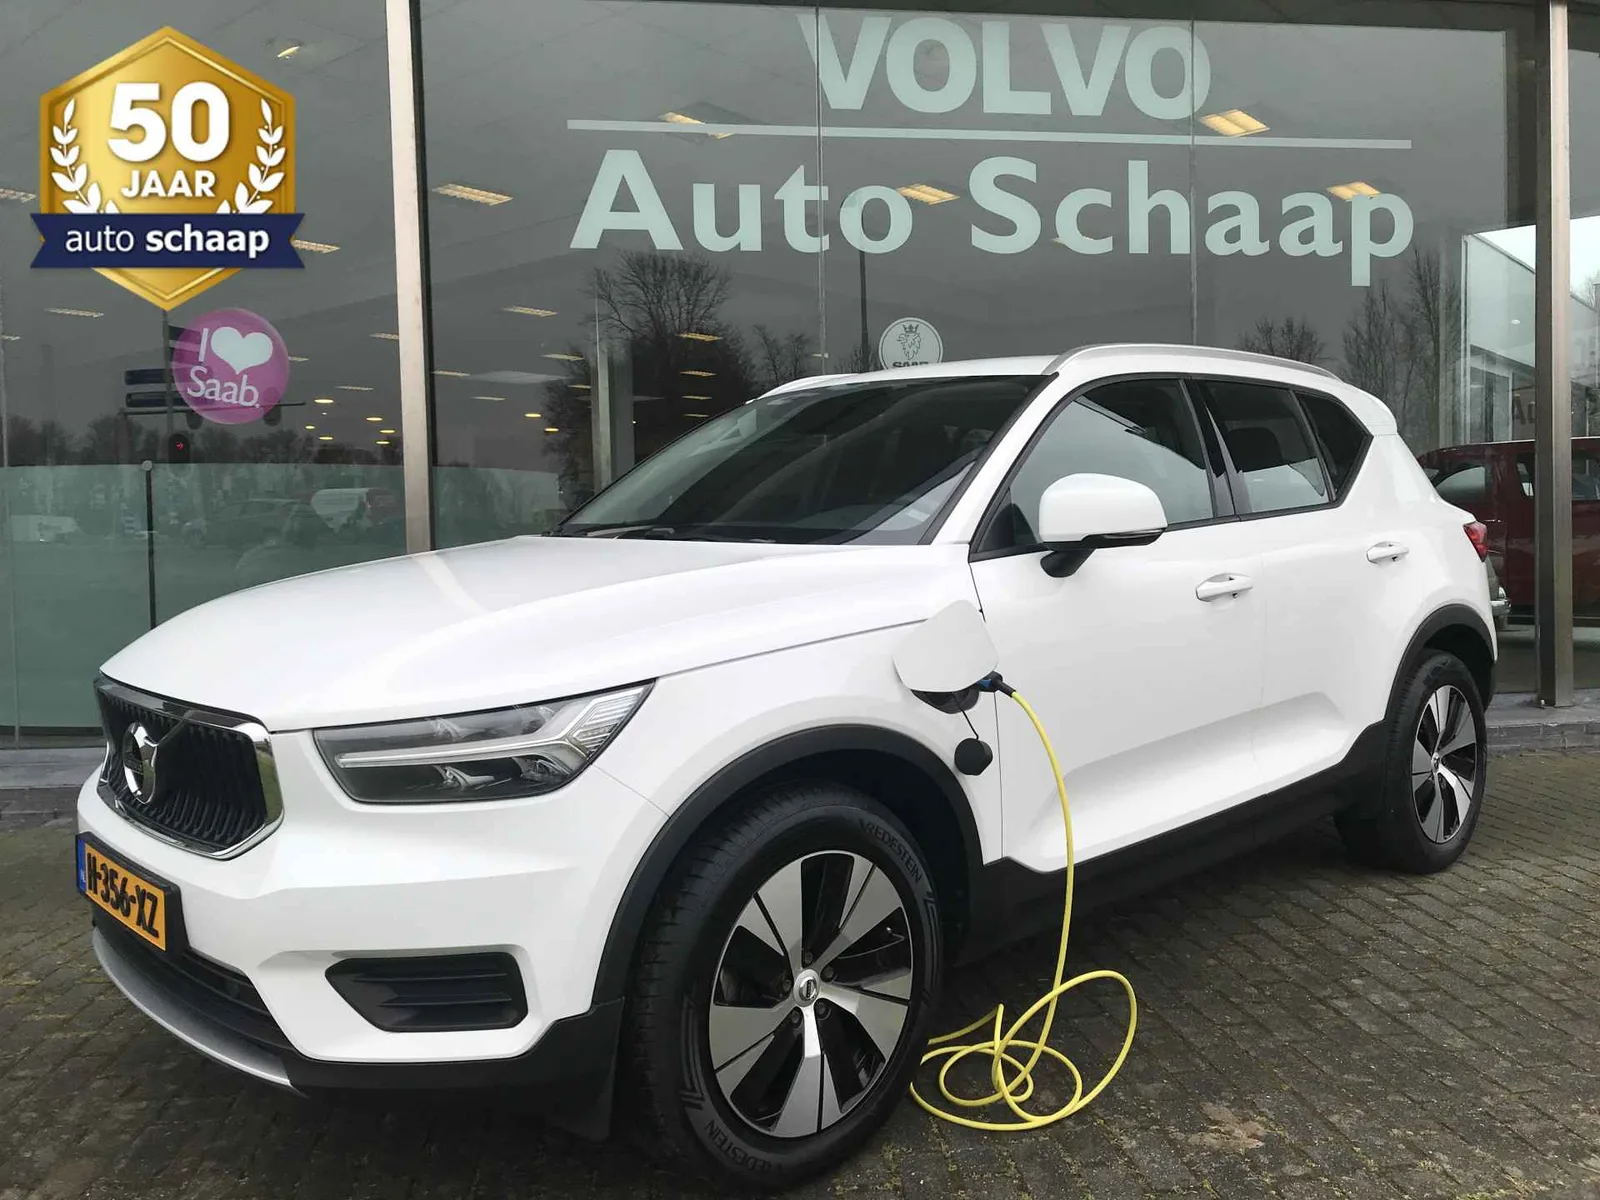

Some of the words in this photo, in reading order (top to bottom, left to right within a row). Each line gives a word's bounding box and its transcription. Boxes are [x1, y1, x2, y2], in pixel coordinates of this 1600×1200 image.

[797, 14, 1211, 120] VOLVO
[569, 150, 913, 254] Auto
[968, 156, 1414, 287] Schaap
[86, 852, 160, 939] H-356-XZ
